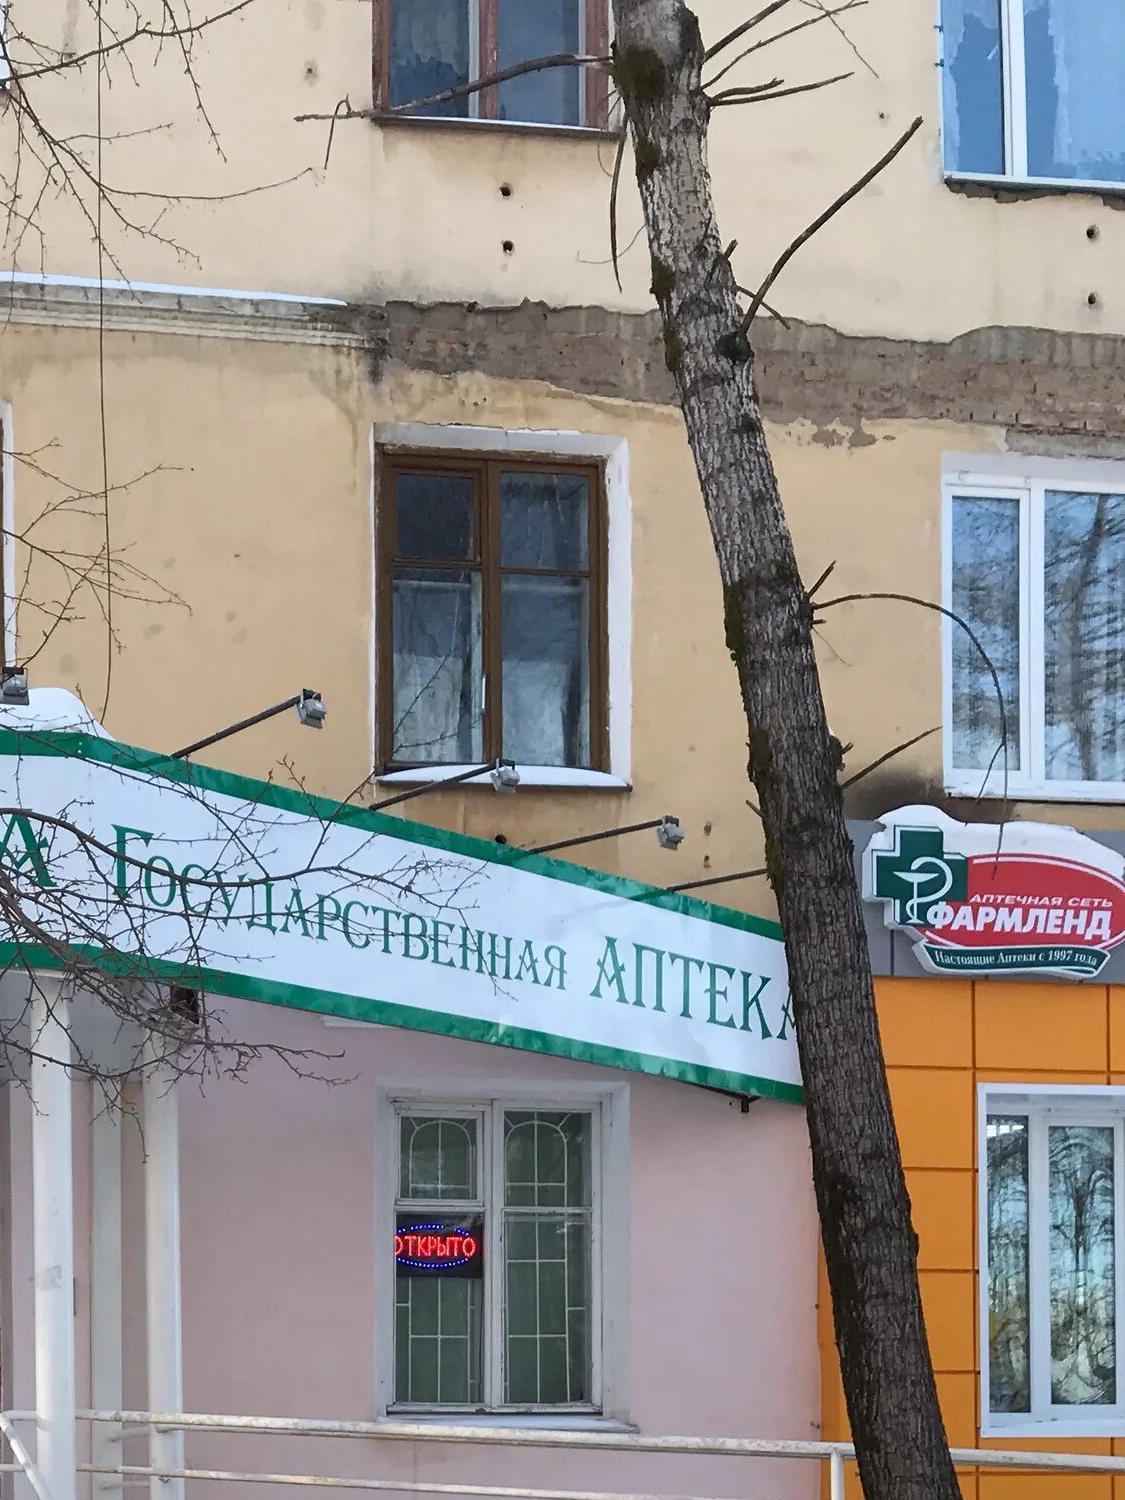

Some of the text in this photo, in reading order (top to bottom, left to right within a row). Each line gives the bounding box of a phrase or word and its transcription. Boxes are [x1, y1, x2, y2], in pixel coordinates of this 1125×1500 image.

[969, 893, 1113, 909] АПТЕЧНАЯ СЕТЬ
[925, 901, 1112, 941] ФАРМЛЕНД
[935, 950, 995, 966] Настоящие
[997, 951, 1036, 965] Аптеки
[1048, 949, 1072, 962] 1997
[1074, 951, 1098, 966] года
[395, 1235, 476, 1257] ОТКРЫТО
